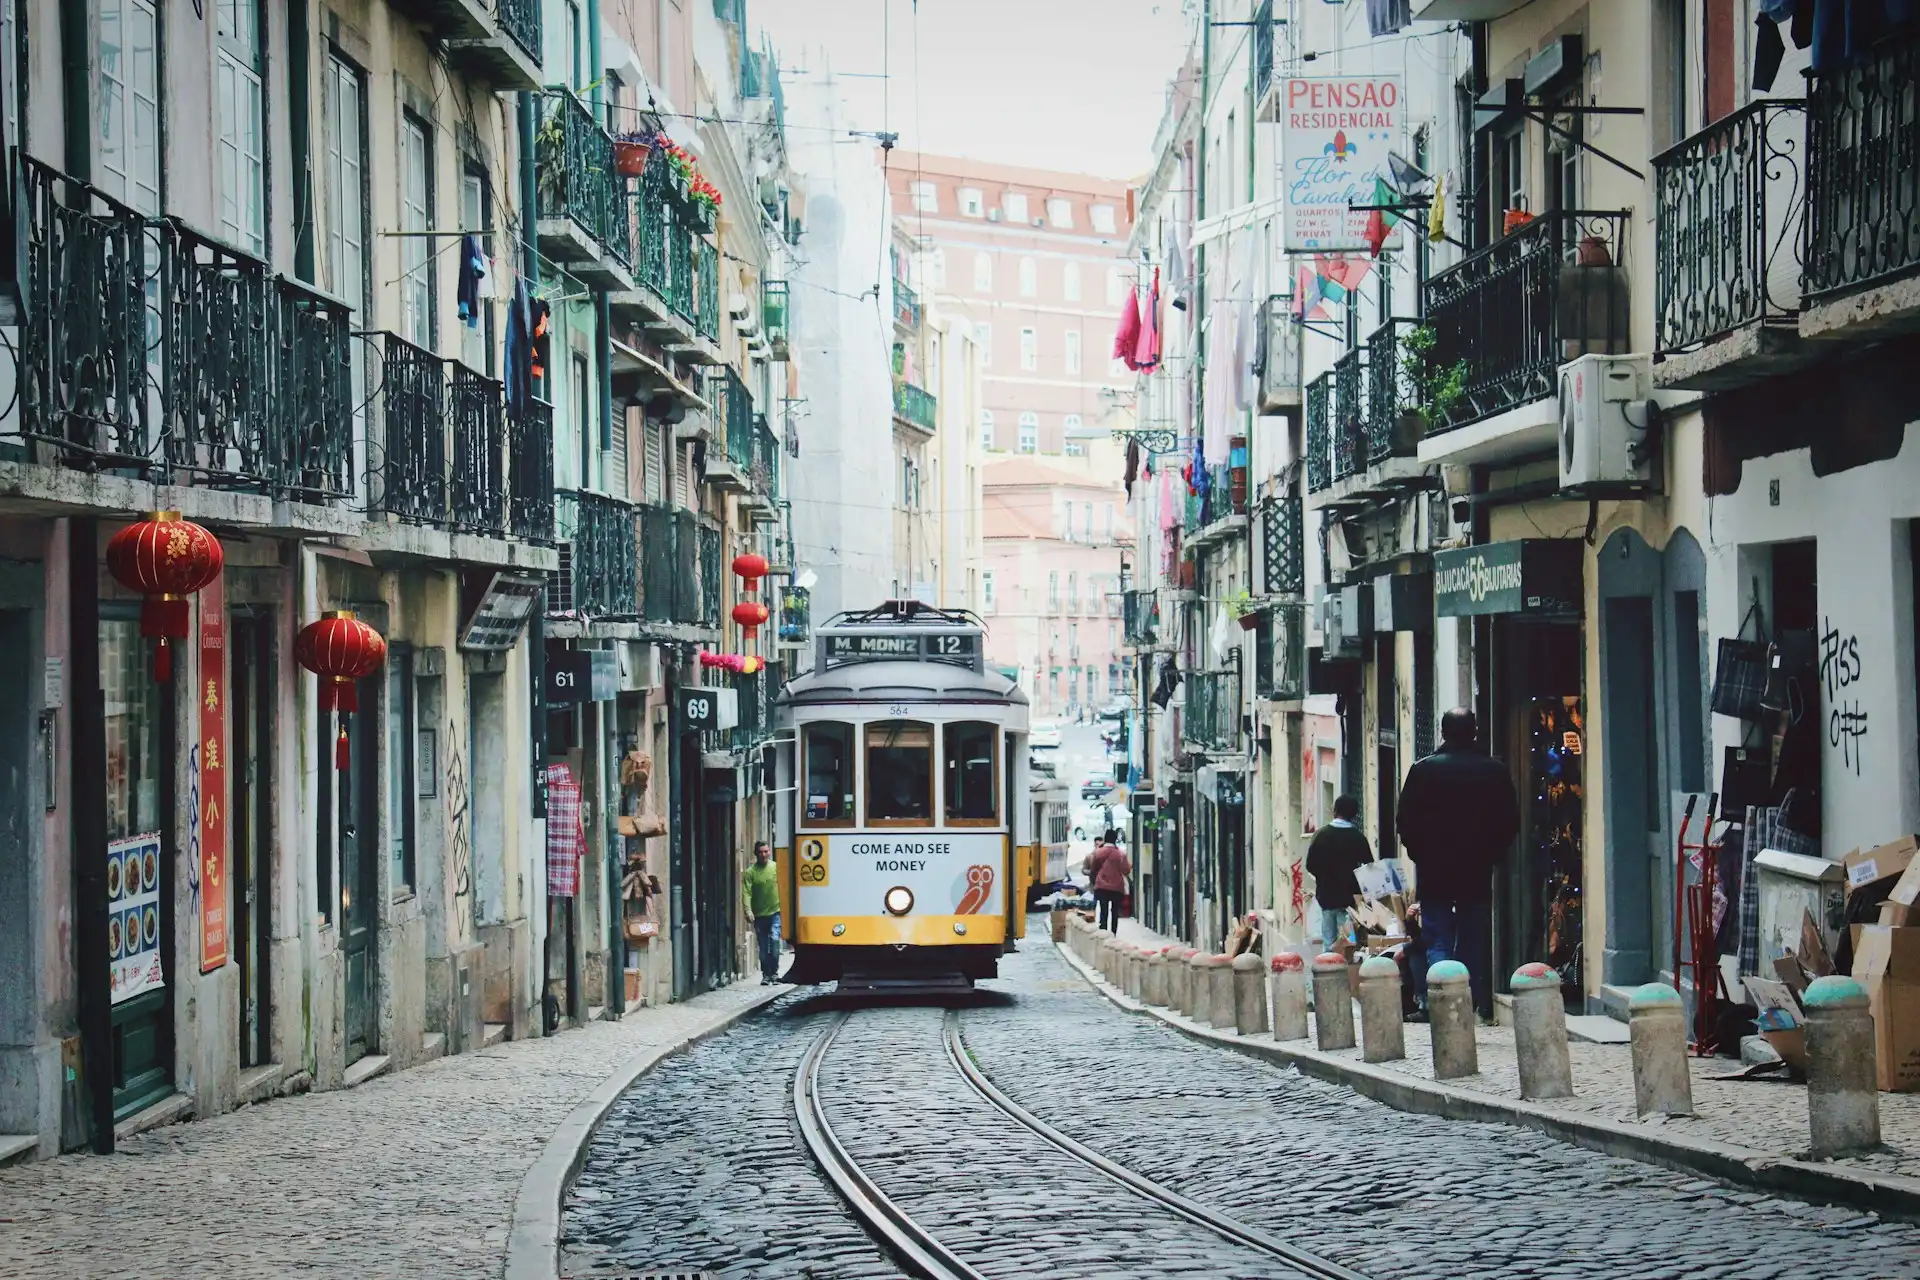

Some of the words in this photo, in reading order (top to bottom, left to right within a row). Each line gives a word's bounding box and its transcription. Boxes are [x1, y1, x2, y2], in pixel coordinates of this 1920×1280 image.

[1290, 111, 1395, 129] RESIDENCIAL
[1295, 156, 1352, 184] Flor
[1295, 207, 1341, 218] QUARTOS
[1295, 229, 1332, 238] PRIVAT
[1469, 555, 1486, 602] 56
[834, 637, 852, 650] M.
[860, 637, 918, 652] MONIZ
[937, 636, 961, 654] 12
[555, 671, 575, 687] 61
[687, 698, 709, 719] 69
[889, 705, 909, 716] 564
[851, 843, 891, 855] COME
[894, 843, 924, 855] AND
[927, 842, 951, 854] SEE
[875, 860, 926, 872] MONEY
